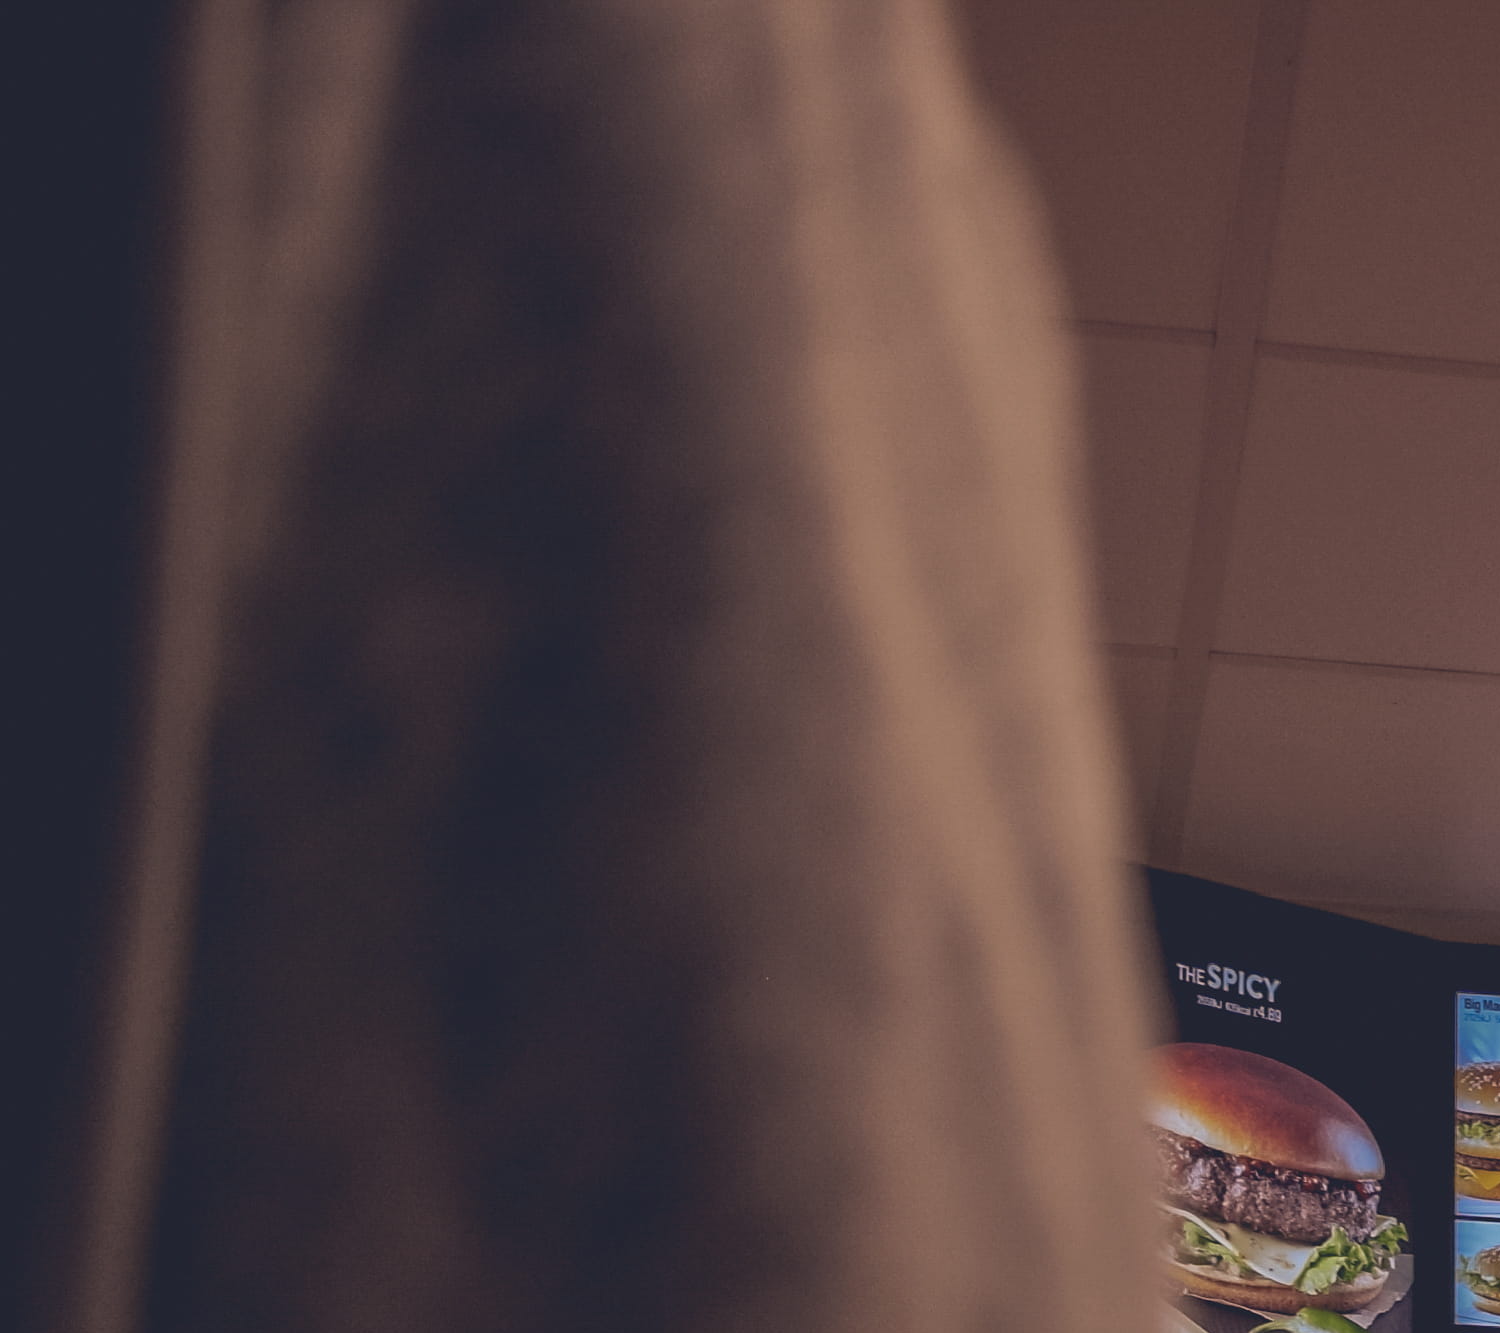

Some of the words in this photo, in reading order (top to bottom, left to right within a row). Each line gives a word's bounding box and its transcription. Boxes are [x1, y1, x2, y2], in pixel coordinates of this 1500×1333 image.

[1176, 963, 1206, 986] THE
[1207, 963, 1281, 1003] SPICY
[1464, 998, 1481, 1013] Big
